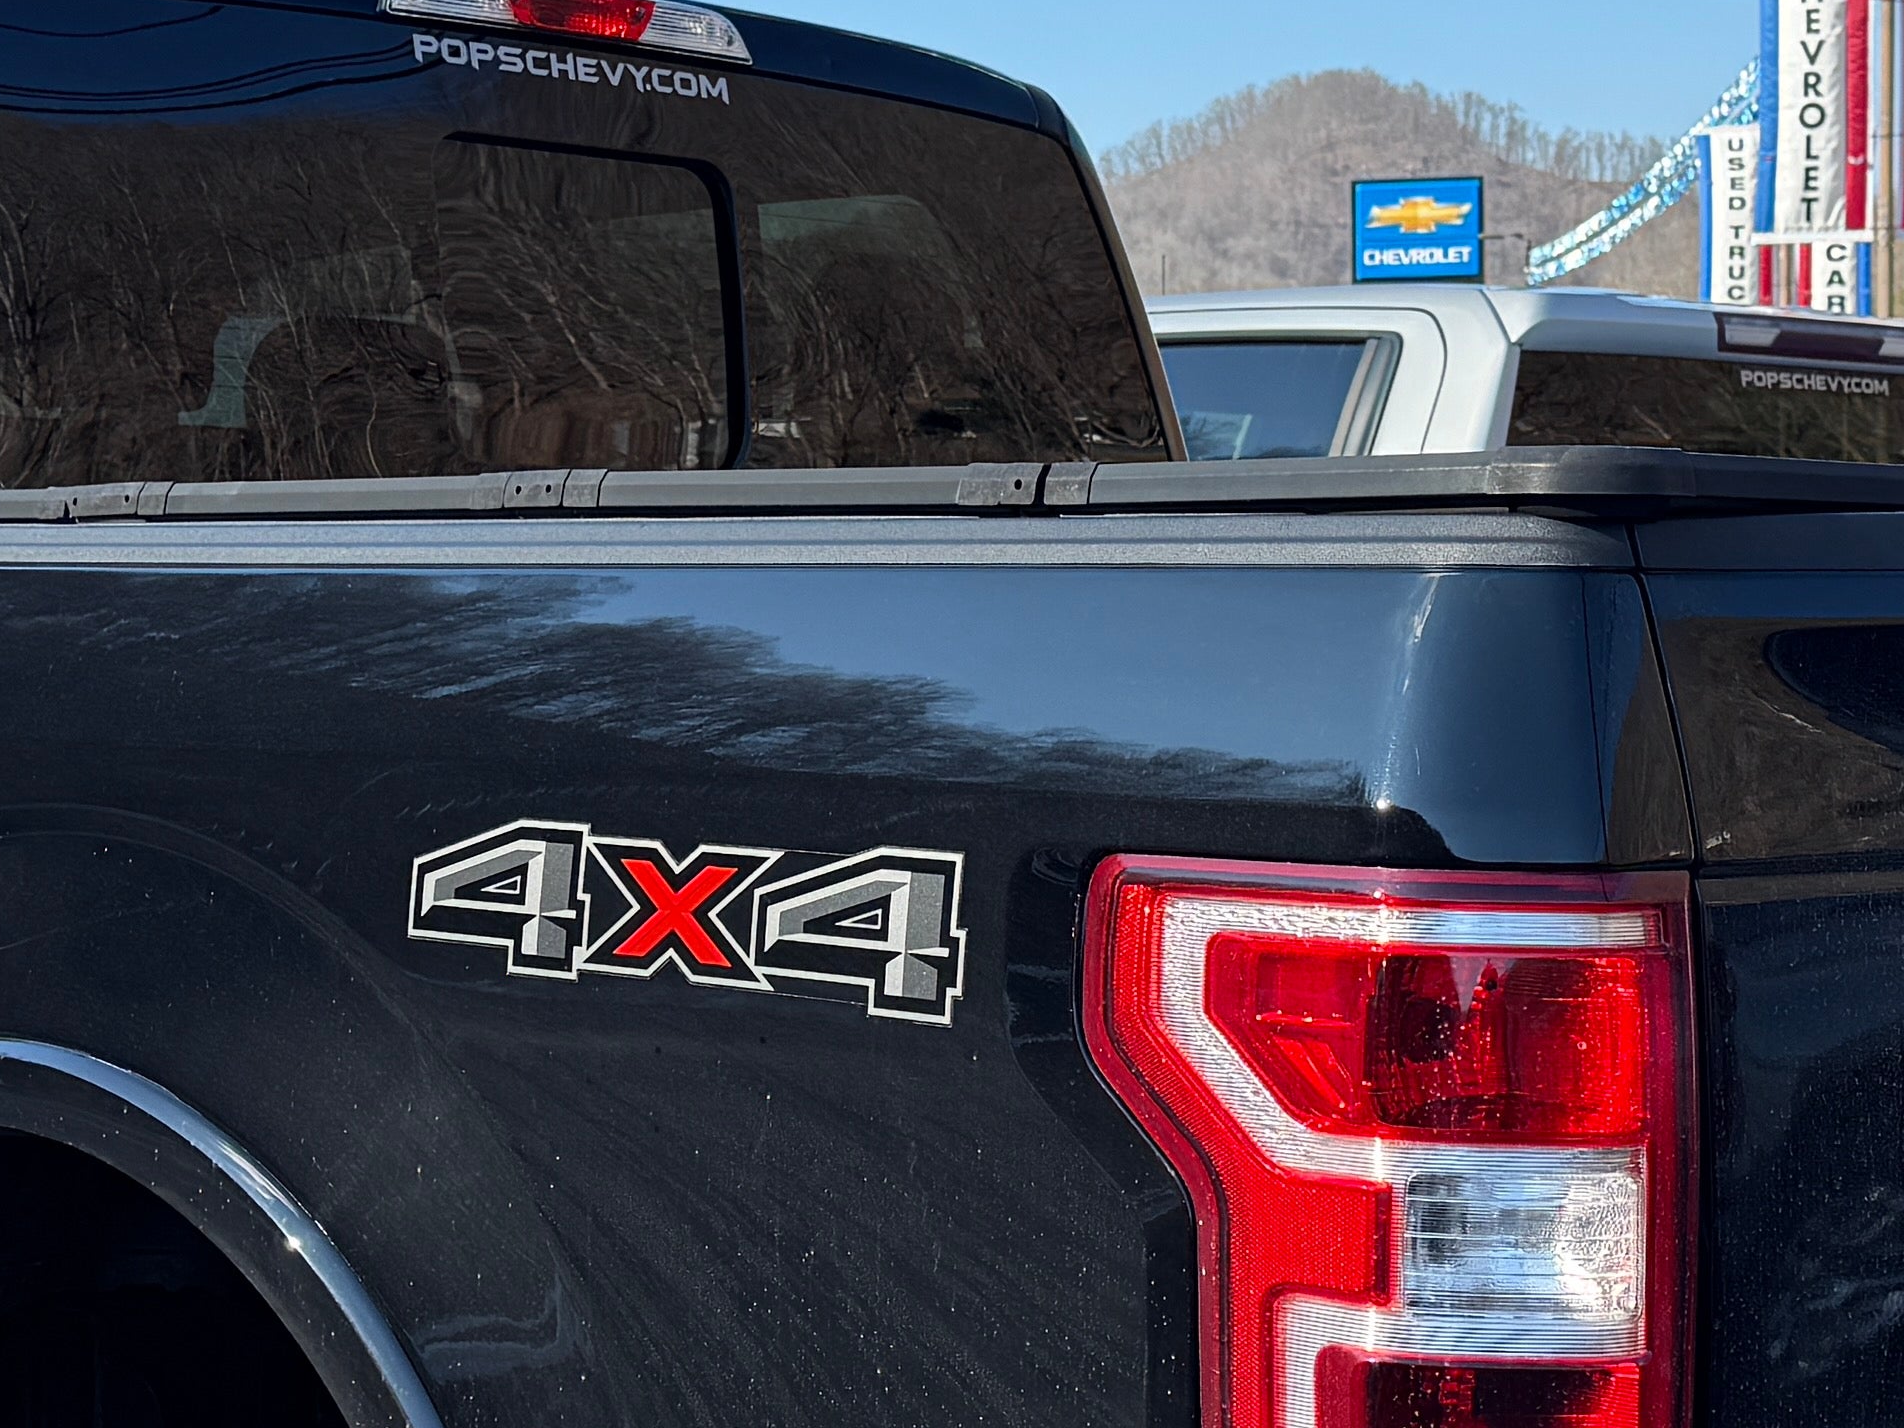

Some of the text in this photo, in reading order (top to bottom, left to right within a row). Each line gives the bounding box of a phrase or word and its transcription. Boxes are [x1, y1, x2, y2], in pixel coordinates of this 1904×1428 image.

[412, 32, 730, 105] POPSCHEVY.COM
[1727, 137, 1747, 211] USED
[1363, 245, 1472, 267] CHEVROLET
[408, 818, 966, 1026] 4X4
